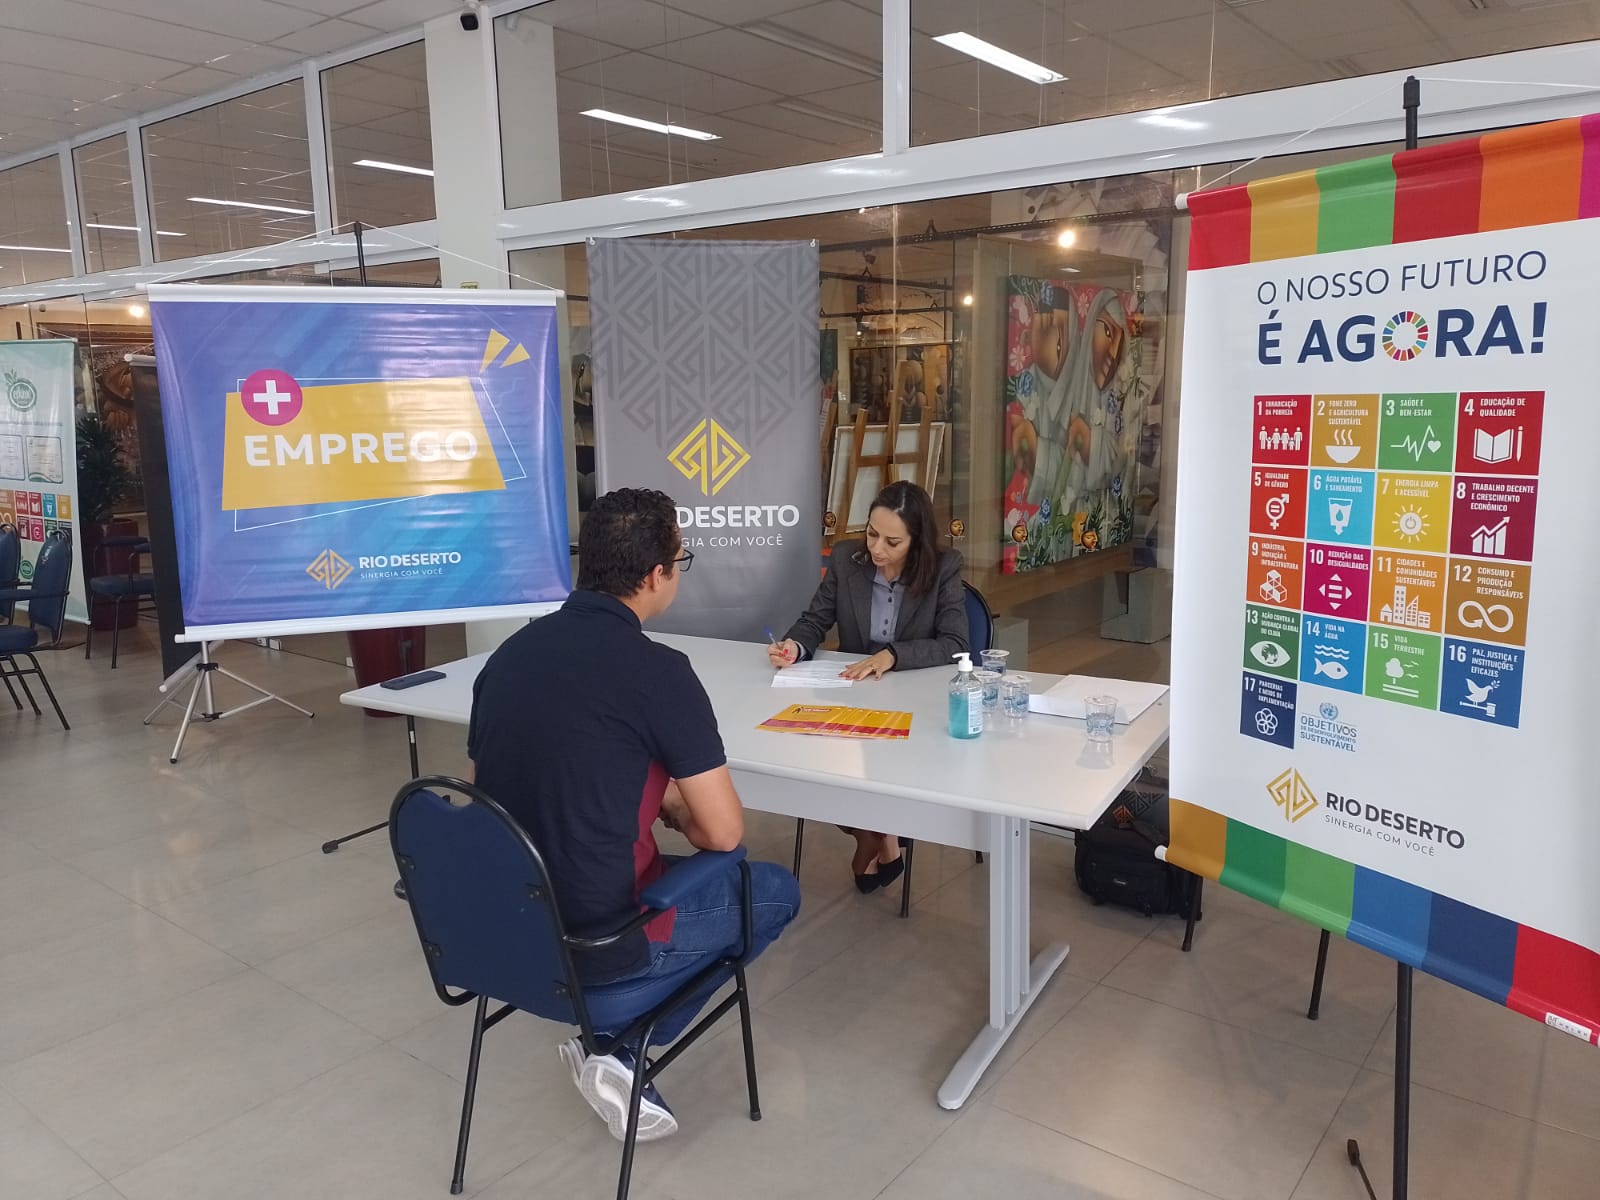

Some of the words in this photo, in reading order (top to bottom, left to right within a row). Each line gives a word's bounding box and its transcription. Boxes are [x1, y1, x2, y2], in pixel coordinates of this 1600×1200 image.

[1257, 281, 1277, 305] O
[1286, 268, 1390, 302] NOSSO
[1401, 250, 1547, 292] FUTURO
[1258, 309, 1282, 365] É
[1297, 301, 1547, 364] AGORA!
[1257, 401, 1263, 416] 1
[1317, 401, 1325, 416] 2
[1386, 400, 1395, 416] 3
[1400, 398, 1419, 407] SAÚDE
[1420, 399, 1424, 407] E
[1464, 398, 1475, 416] 4
[1480, 397, 1515, 408] EDUCAÇÃO
[1517, 398, 1526, 406] DE
[1480, 409, 1516, 417] QUALIDADE
[244, 430, 479, 467] EMPREGO
[1254, 472, 1261, 486] 5
[1313, 475, 1322, 490] 6
[1326, 473, 1340, 483] ÁGUA
[1395, 479, 1419, 488] ENERGIA
[1381, 478, 1390, 495] 7
[1400, 488, 1429, 497] ACESSÍVEL
[1456, 482, 1466, 499] 8
[1472, 483, 1505, 493] TRABALHO
[1506, 485, 1535, 494] DECENTE
[1477, 494, 1520, 503] CRESCIMENTO
[1471, 502, 1508, 512] ECONÔMICO
[675, 505, 800, 528] DESERTO
[709, 536, 741, 547] COM
[746, 533, 784, 546] VOCÊ
[1251, 542, 1259, 556] 9
[1328, 550, 1352, 560] REDUÇÃO
[1353, 553, 1364, 561] DAS
[359, 555, 388, 569] RIO
[390, 551, 462, 567] DESERTO
[1309, 548, 1324, 565] 10
[1396, 558, 1421, 567] CIDADES
[1328, 560, 1369, 571] DESIGUALDADES
[1376, 556, 1392, 573] 11
[360, 571, 398, 580] SINERGIA
[422, 567, 443, 576] VOCÊ
[1396, 567, 1437, 578] COMUNIDADES
[1453, 564, 1472, 583] 12
[1477, 566, 1509, 577] CONSUMO
[1510, 570, 1515, 578] E
[1396, 576, 1436, 587] SUSTENTÁVEIS
[1477, 577, 1513, 588] PRODUÇÃO
[1477, 586, 1524, 599] RESPONSÁVEIS
[1246, 609, 1258, 624] 13
[1261, 611, 1273, 619] AÇÃO
[1274, 614, 1291, 622] CONTRA
[1306, 620, 1320, 637] 14
[1325, 623, 1336, 632] VIDA
[1337, 625, 1345, 633] NA
[1324, 631, 1338, 640] ÁGUA
[1373, 632, 1389, 649] 15
[1394, 635, 1408, 644] VIDA
[1449, 644, 1467, 663] 16
[1472, 647, 1486, 657] PAZ,
[1487, 649, 1513, 662] JUSTIÇA
[1514, 655, 1519, 663] E
[1471, 656, 1514, 671] INSTITUIÇÕES
[1471, 666, 1499, 678] EFICAZES
[1244, 676, 1256, 692] 17
[1259, 680, 1283, 692] PARCERIAS
[1276, 691, 1282, 699] DE
[1258, 695, 1295, 710] IMPLEMENTAÇÃO
[1300, 715, 1357, 738] OBJETIVOS
[1326, 792, 1361, 817] RIO
[1365, 803, 1465, 849] DESERTO
[1325, 814, 1373, 836] SINERGIA
[1376, 831, 1401, 846] COM
[1405, 840, 1435, 857] VOCÊ
